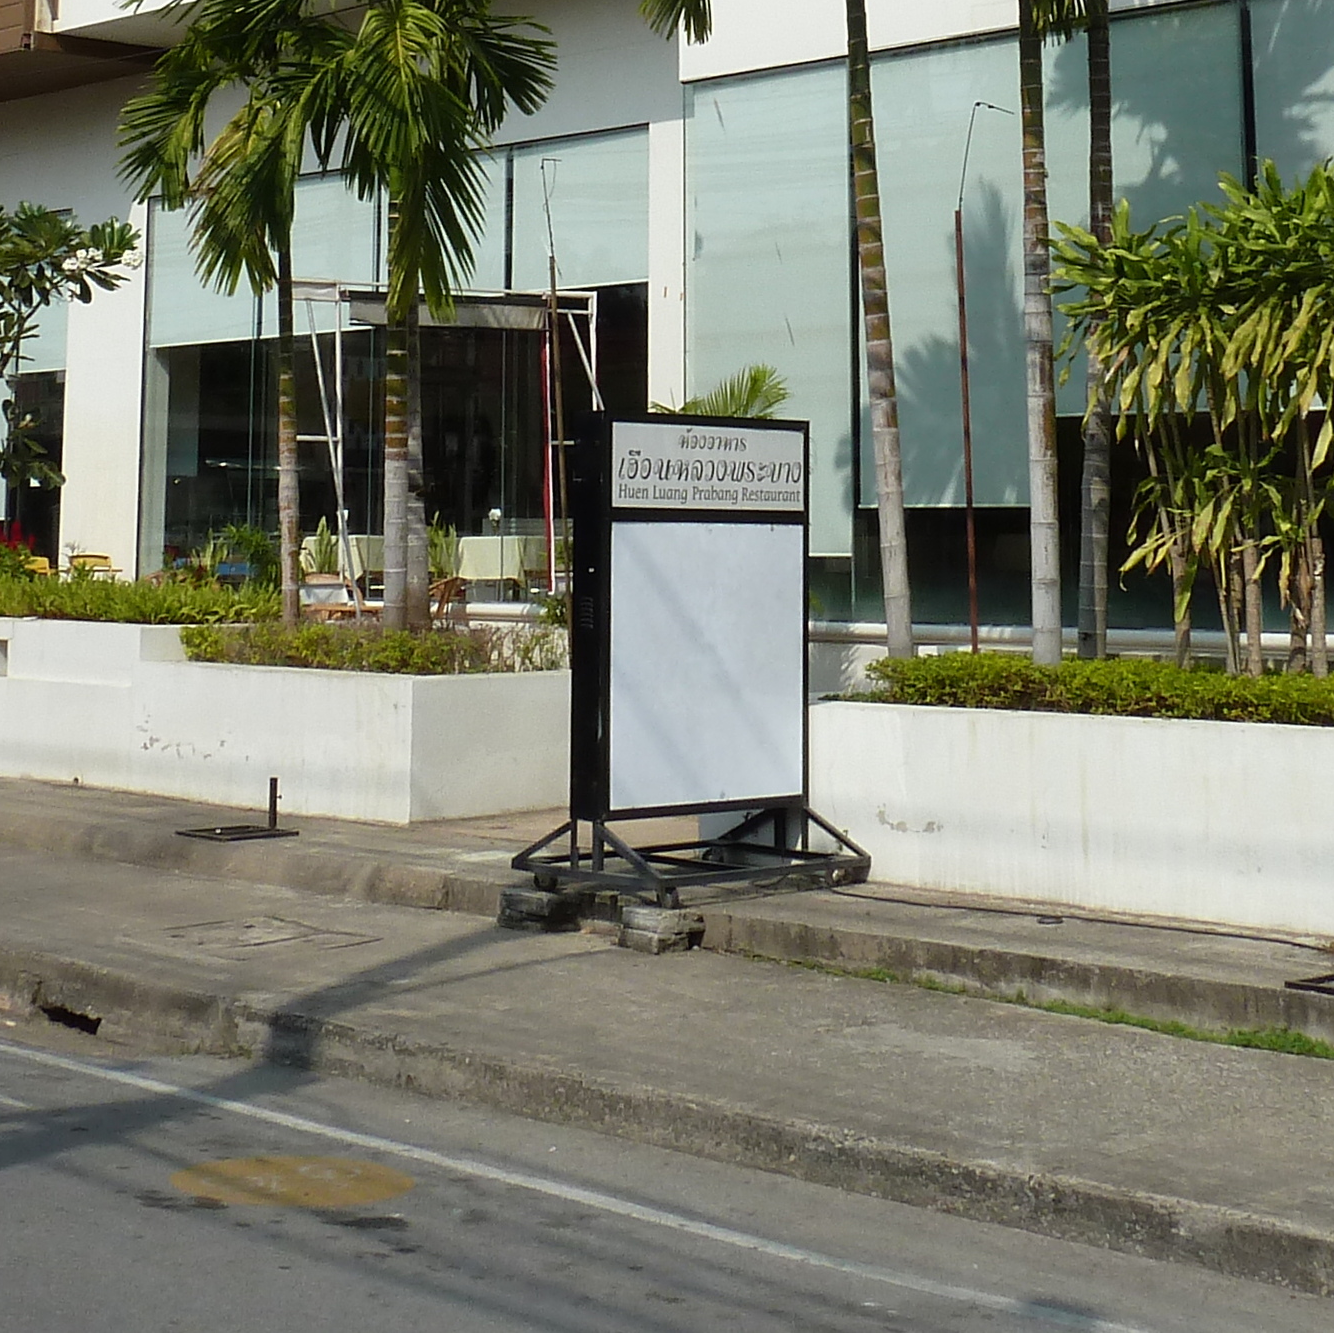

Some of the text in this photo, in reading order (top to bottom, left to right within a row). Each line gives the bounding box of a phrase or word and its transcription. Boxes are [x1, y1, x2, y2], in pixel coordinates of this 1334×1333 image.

[618, 484, 801, 505] Huen Luang Prabang Restaurant
